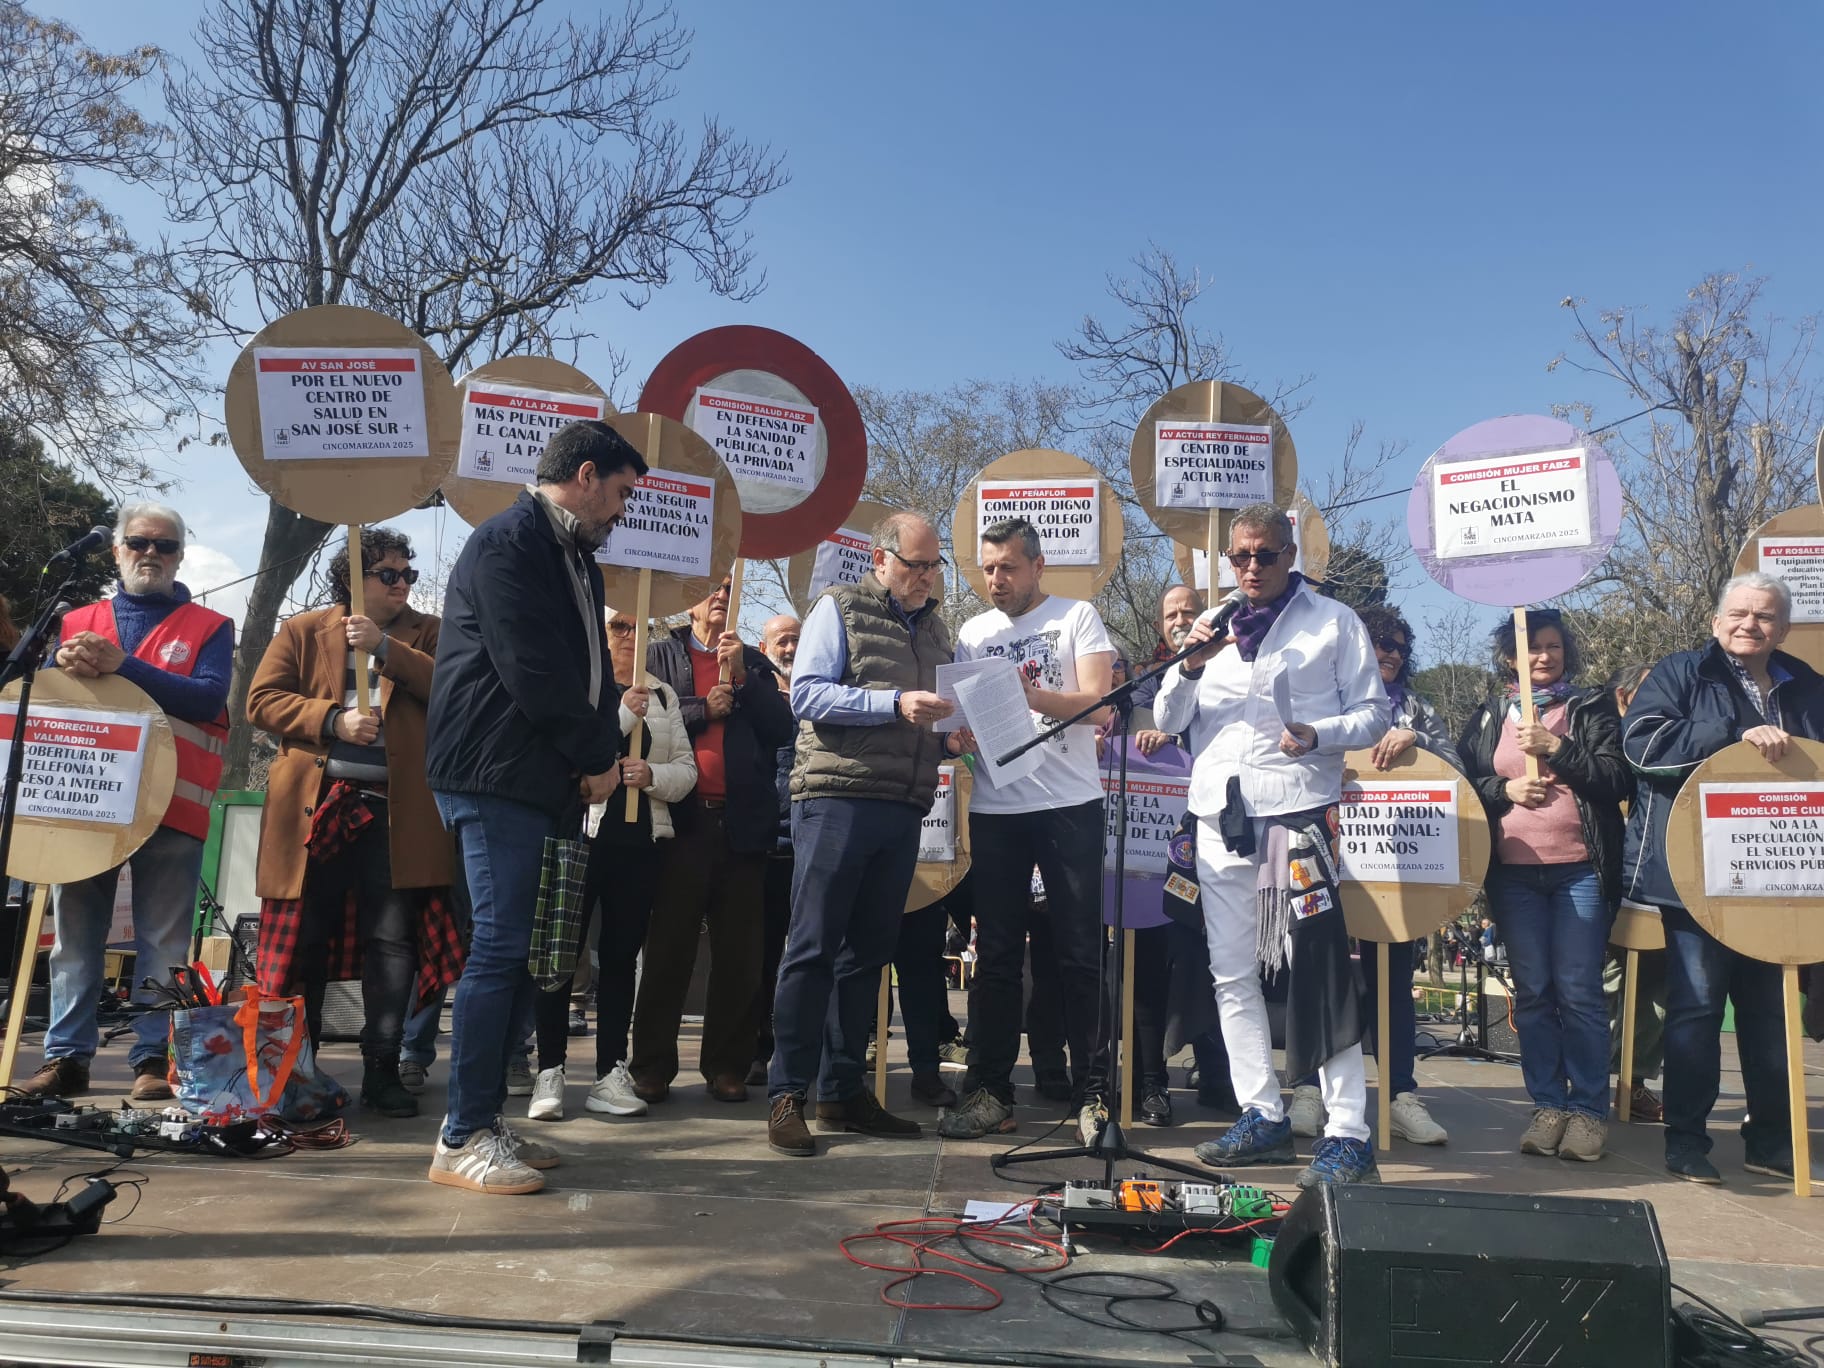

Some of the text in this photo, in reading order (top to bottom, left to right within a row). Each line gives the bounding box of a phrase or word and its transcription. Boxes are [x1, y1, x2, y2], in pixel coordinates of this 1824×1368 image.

[301, 360, 377, 370] AV SAN JOSÉ
[291, 374, 403, 387] POR EL NUEVO
[305, 390, 393, 404] CENTRO DE
[313, 406, 387, 420] SALUD EN
[509, 399, 560, 413] AV LA PAZ
[708, 398, 807, 421] COMISIÓN SALUD FABZ
[475, 406, 505, 422] MÁS
[291, 423, 321, 436] SAN
[326, 420, 364, 436] JOSÉ
[368, 422, 399, 435] SUR
[717, 410, 808, 436] EN DEFENSA DE
[477, 423, 494, 437] EL
[498, 426, 545, 443] CANAL
[727, 426, 796, 446] LA SANIDAD
[1162, 431, 1267, 443] AV ACTUR REY FERNANDO
[322, 441, 414, 451] CINCOMARZADA 2025
[506, 442, 544, 458] LA PA
[715, 437, 770, 456] PÚBLICA,
[786, 448, 794, 459] €
[798, 451, 806, 461] A
[1181, 443, 1250, 456] CENTRO DE
[725, 453, 794, 473] LA PRIVADA
[1164, 456, 1266, 471] ESPECIALIDADES
[506, 466, 537, 477] CINCOM
[735, 467, 804, 484] CINCOMARZADA 2025
[1181, 471, 1249, 484] ACTUR YA!!
[1450, 460, 1571, 482] COMISIÓN MUJER FABZ
[646, 479, 688, 493] FUENTES
[1022, 488, 1067, 497] PEÑAFLOR
[1501, 479, 1520, 492] EL
[656, 493, 697, 510] SEGUIR
[1200, 490, 1250, 500] CINCOMARZADA
[1449, 488, 1575, 516] NEGACIONISMO
[984, 499, 1091, 512] COMEDOR DIGNO
[638, 504, 682, 522] AYUDAS
[684, 512, 692, 523] A
[695, 513, 709, 525] LA
[1038, 514, 1093, 525] COLEGIO
[1490, 511, 1535, 527] MATA
[1038, 528, 1080, 539] AFLOR
[1493, 529, 1579, 544] CINCOMARZADA 2025
[840, 537, 850, 545] AV
[624, 548, 700, 565] CINCOMARZADA 2025
[842, 560, 856, 571] DE
[26, 719, 110, 734] AV TORRECILLA
[33, 732, 96, 746] VALMADRID
[101, 752, 118, 763] DE
[26, 759, 107, 776] TELEFONÍA Y
[57, 778, 66, 787] A
[70, 777, 124, 793] INTERET
[1131, 783, 1163, 793] MUJER
[22, 787, 99, 804] DE CALIDAD
[934, 790, 949, 799] or
[1350, 793, 1388, 801] CIUDAD
[1391, 792, 1430, 801] JARDÍN
[1759, 794, 1808, 802] COMISIÓN
[1143, 796, 1160, 808] LA
[28, 804, 116, 819] CINCOMARZADA 2025
[1385, 803, 1446, 819] JARDÍN
[1730, 807, 1779, 815] MODELO
[1782, 807, 1798, 815] DE
[1769, 819, 1818, 829] NO A LA
[1131, 827, 1151, 839] DE
[1155, 829, 1175, 841] LA
[1731, 831, 1823, 844] ESPECULACIÓN
[1347, 839, 1418, 854] 91 AÑOS
[1746, 847, 1761, 857] EL
[1765, 846, 1805, 857] SUELO
[1809, 846, 1817, 856] Y
[1360, 863, 1444, 871] CINCOMARZADA 2025
[1730, 860, 1796, 871] SERVICIOS
